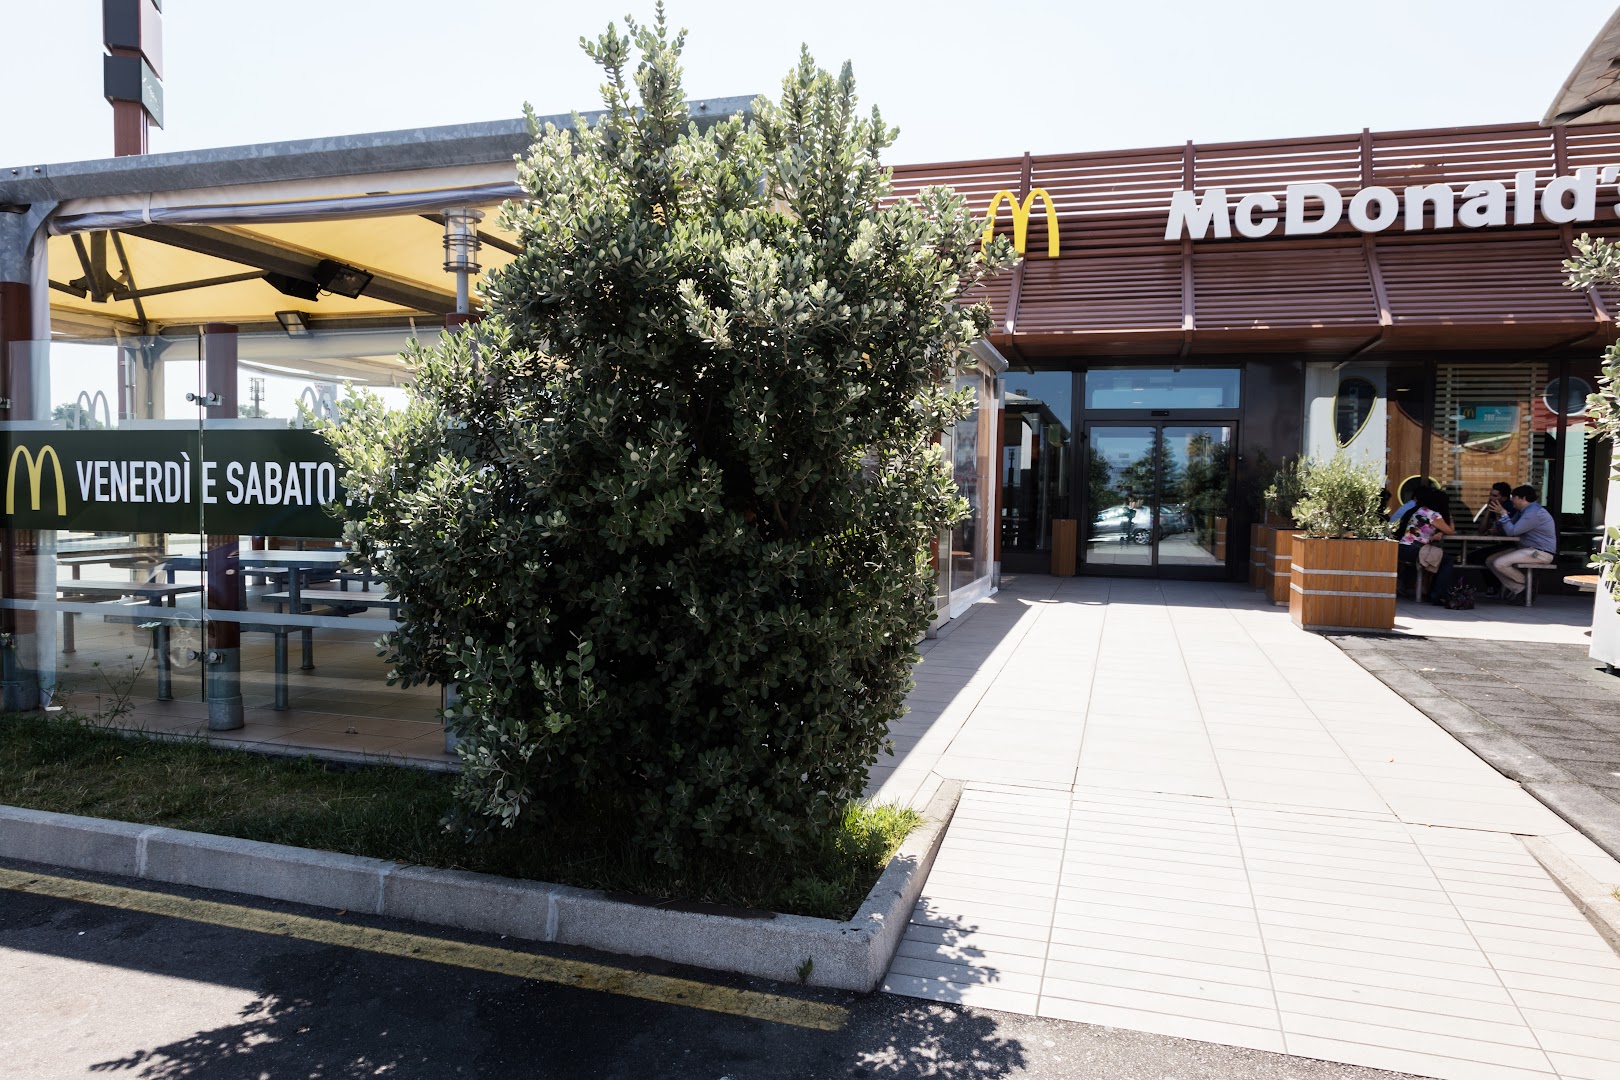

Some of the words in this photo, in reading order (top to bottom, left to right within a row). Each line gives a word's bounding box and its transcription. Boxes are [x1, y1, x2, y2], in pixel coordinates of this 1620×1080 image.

[1164, 167, 1620, 240] McDonald'
[75, 451, 191, 504] VENERDÌ
[203, 461, 218, 504] E
[226, 461, 336, 506] SABATO
